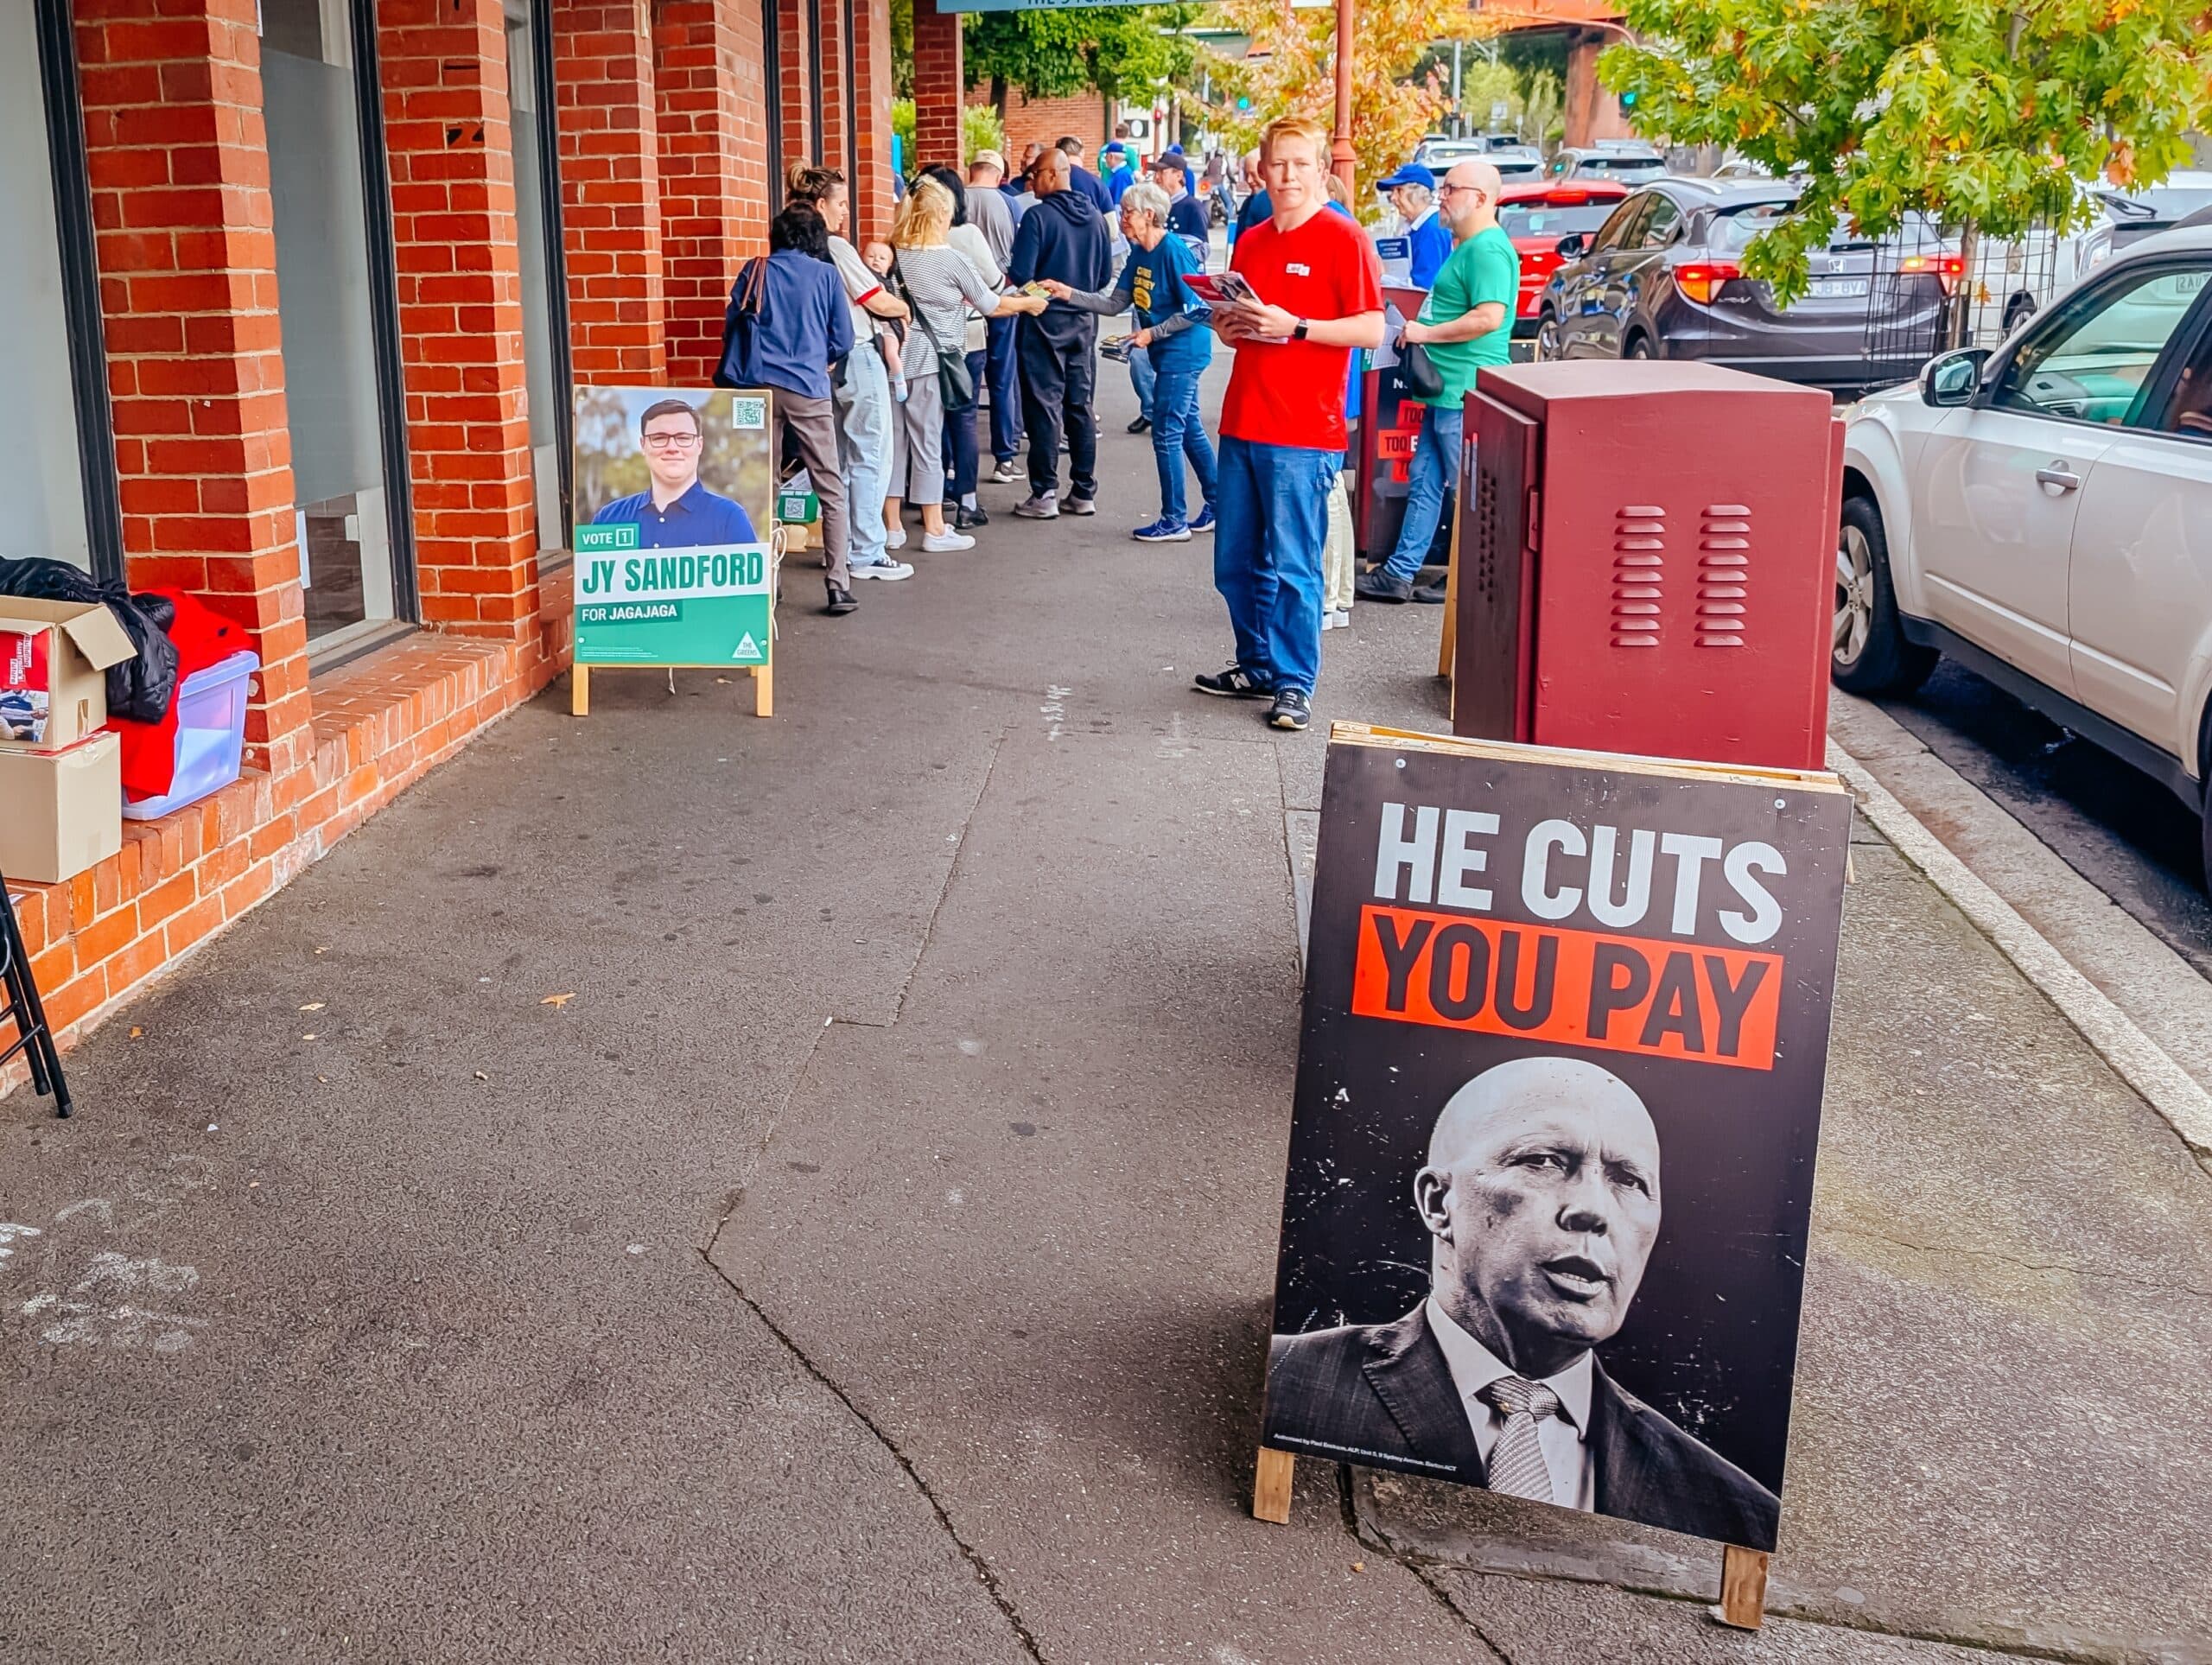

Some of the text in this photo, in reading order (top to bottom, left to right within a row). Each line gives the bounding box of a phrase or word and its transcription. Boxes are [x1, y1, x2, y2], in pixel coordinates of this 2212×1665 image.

[1385, 436, 1408, 452] TOO
[582, 532, 613, 545] VOTE
[582, 552, 763, 594] JY SANDFORD
[582, 604, 677, 621] FOR JAGAJAGA
[1374, 803, 1788, 944] HE CUTS
[1372, 913, 1770, 1057] YOU PAY
